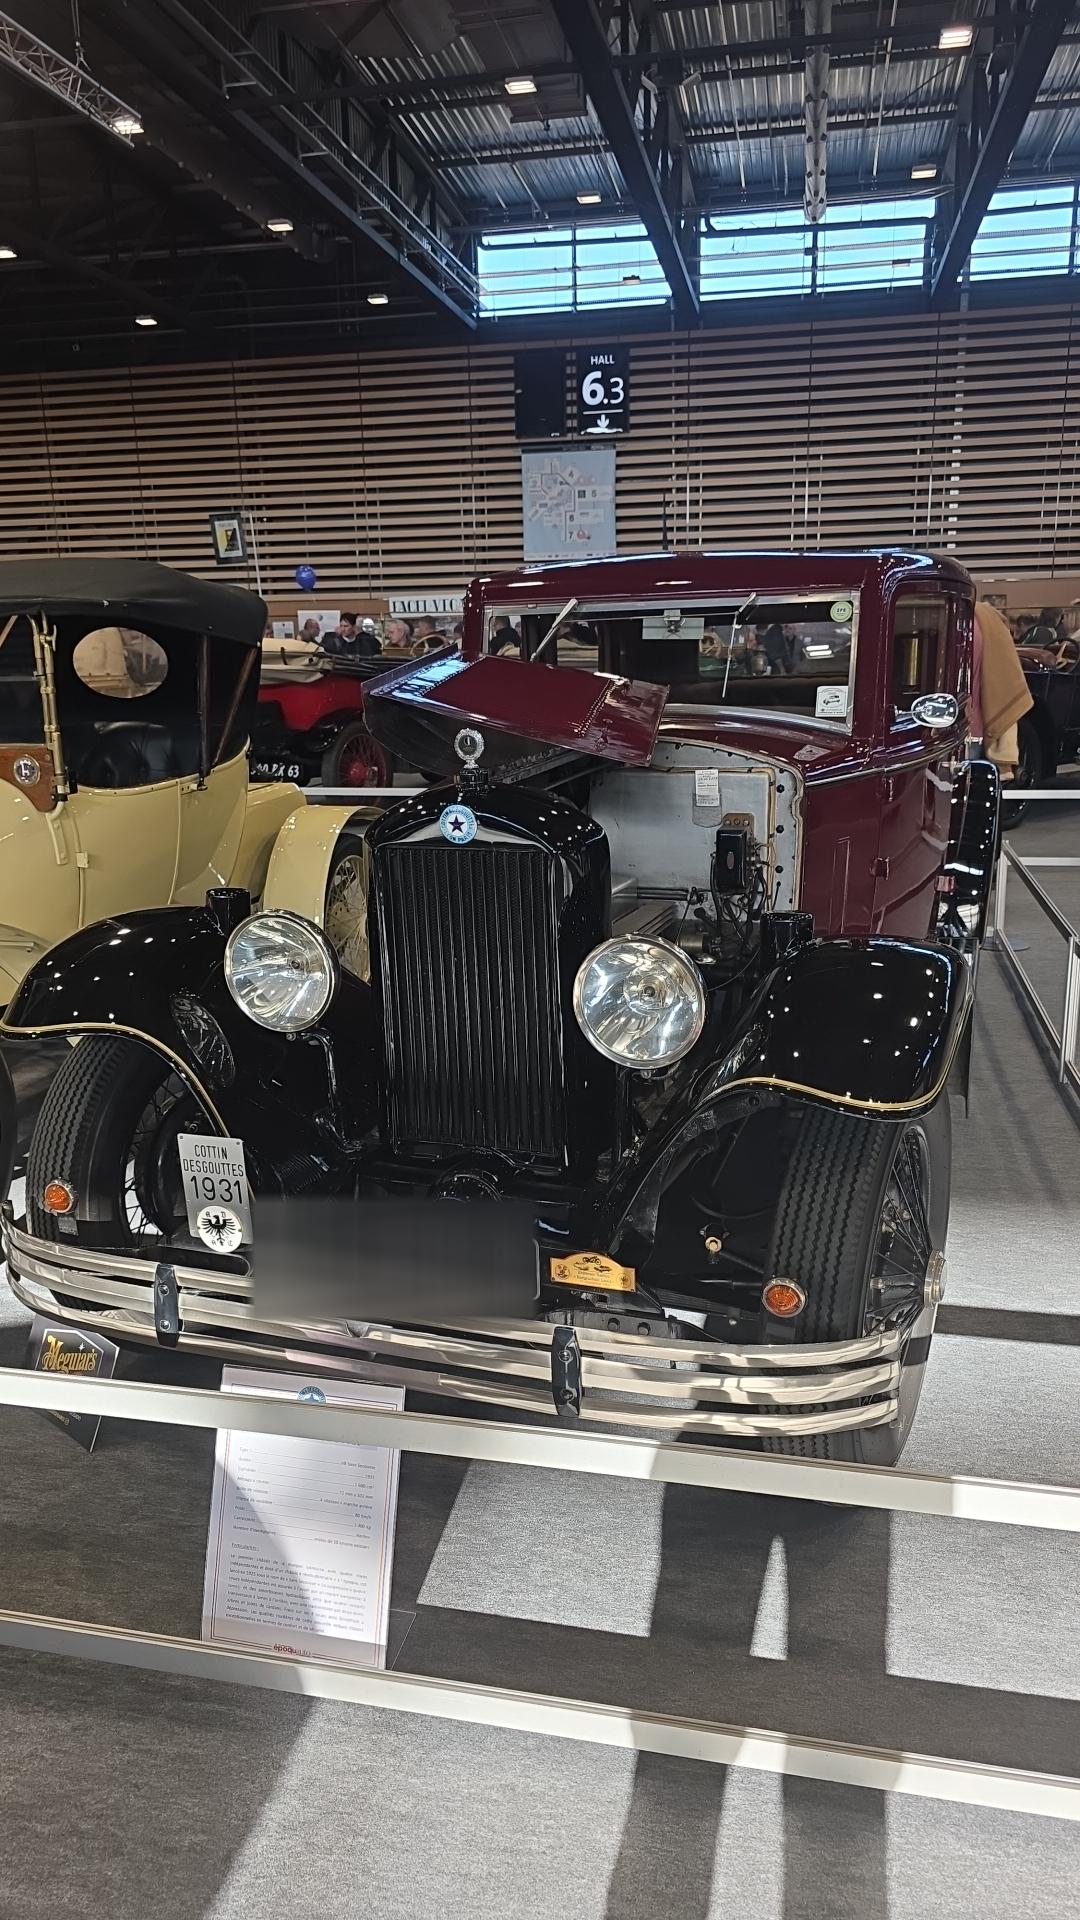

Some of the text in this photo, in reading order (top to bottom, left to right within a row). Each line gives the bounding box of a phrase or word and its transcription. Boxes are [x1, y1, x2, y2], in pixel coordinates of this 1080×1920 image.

[590, 354, 615, 366] HALL
[581, 370, 625, 406] 6.3
[287, 764, 300, 778] 63
[194, 1144, 228, 1160] COTTIN
[183, 1158, 244, 1177] DESGOUTTES
[190, 1175, 243, 1205] 1931
